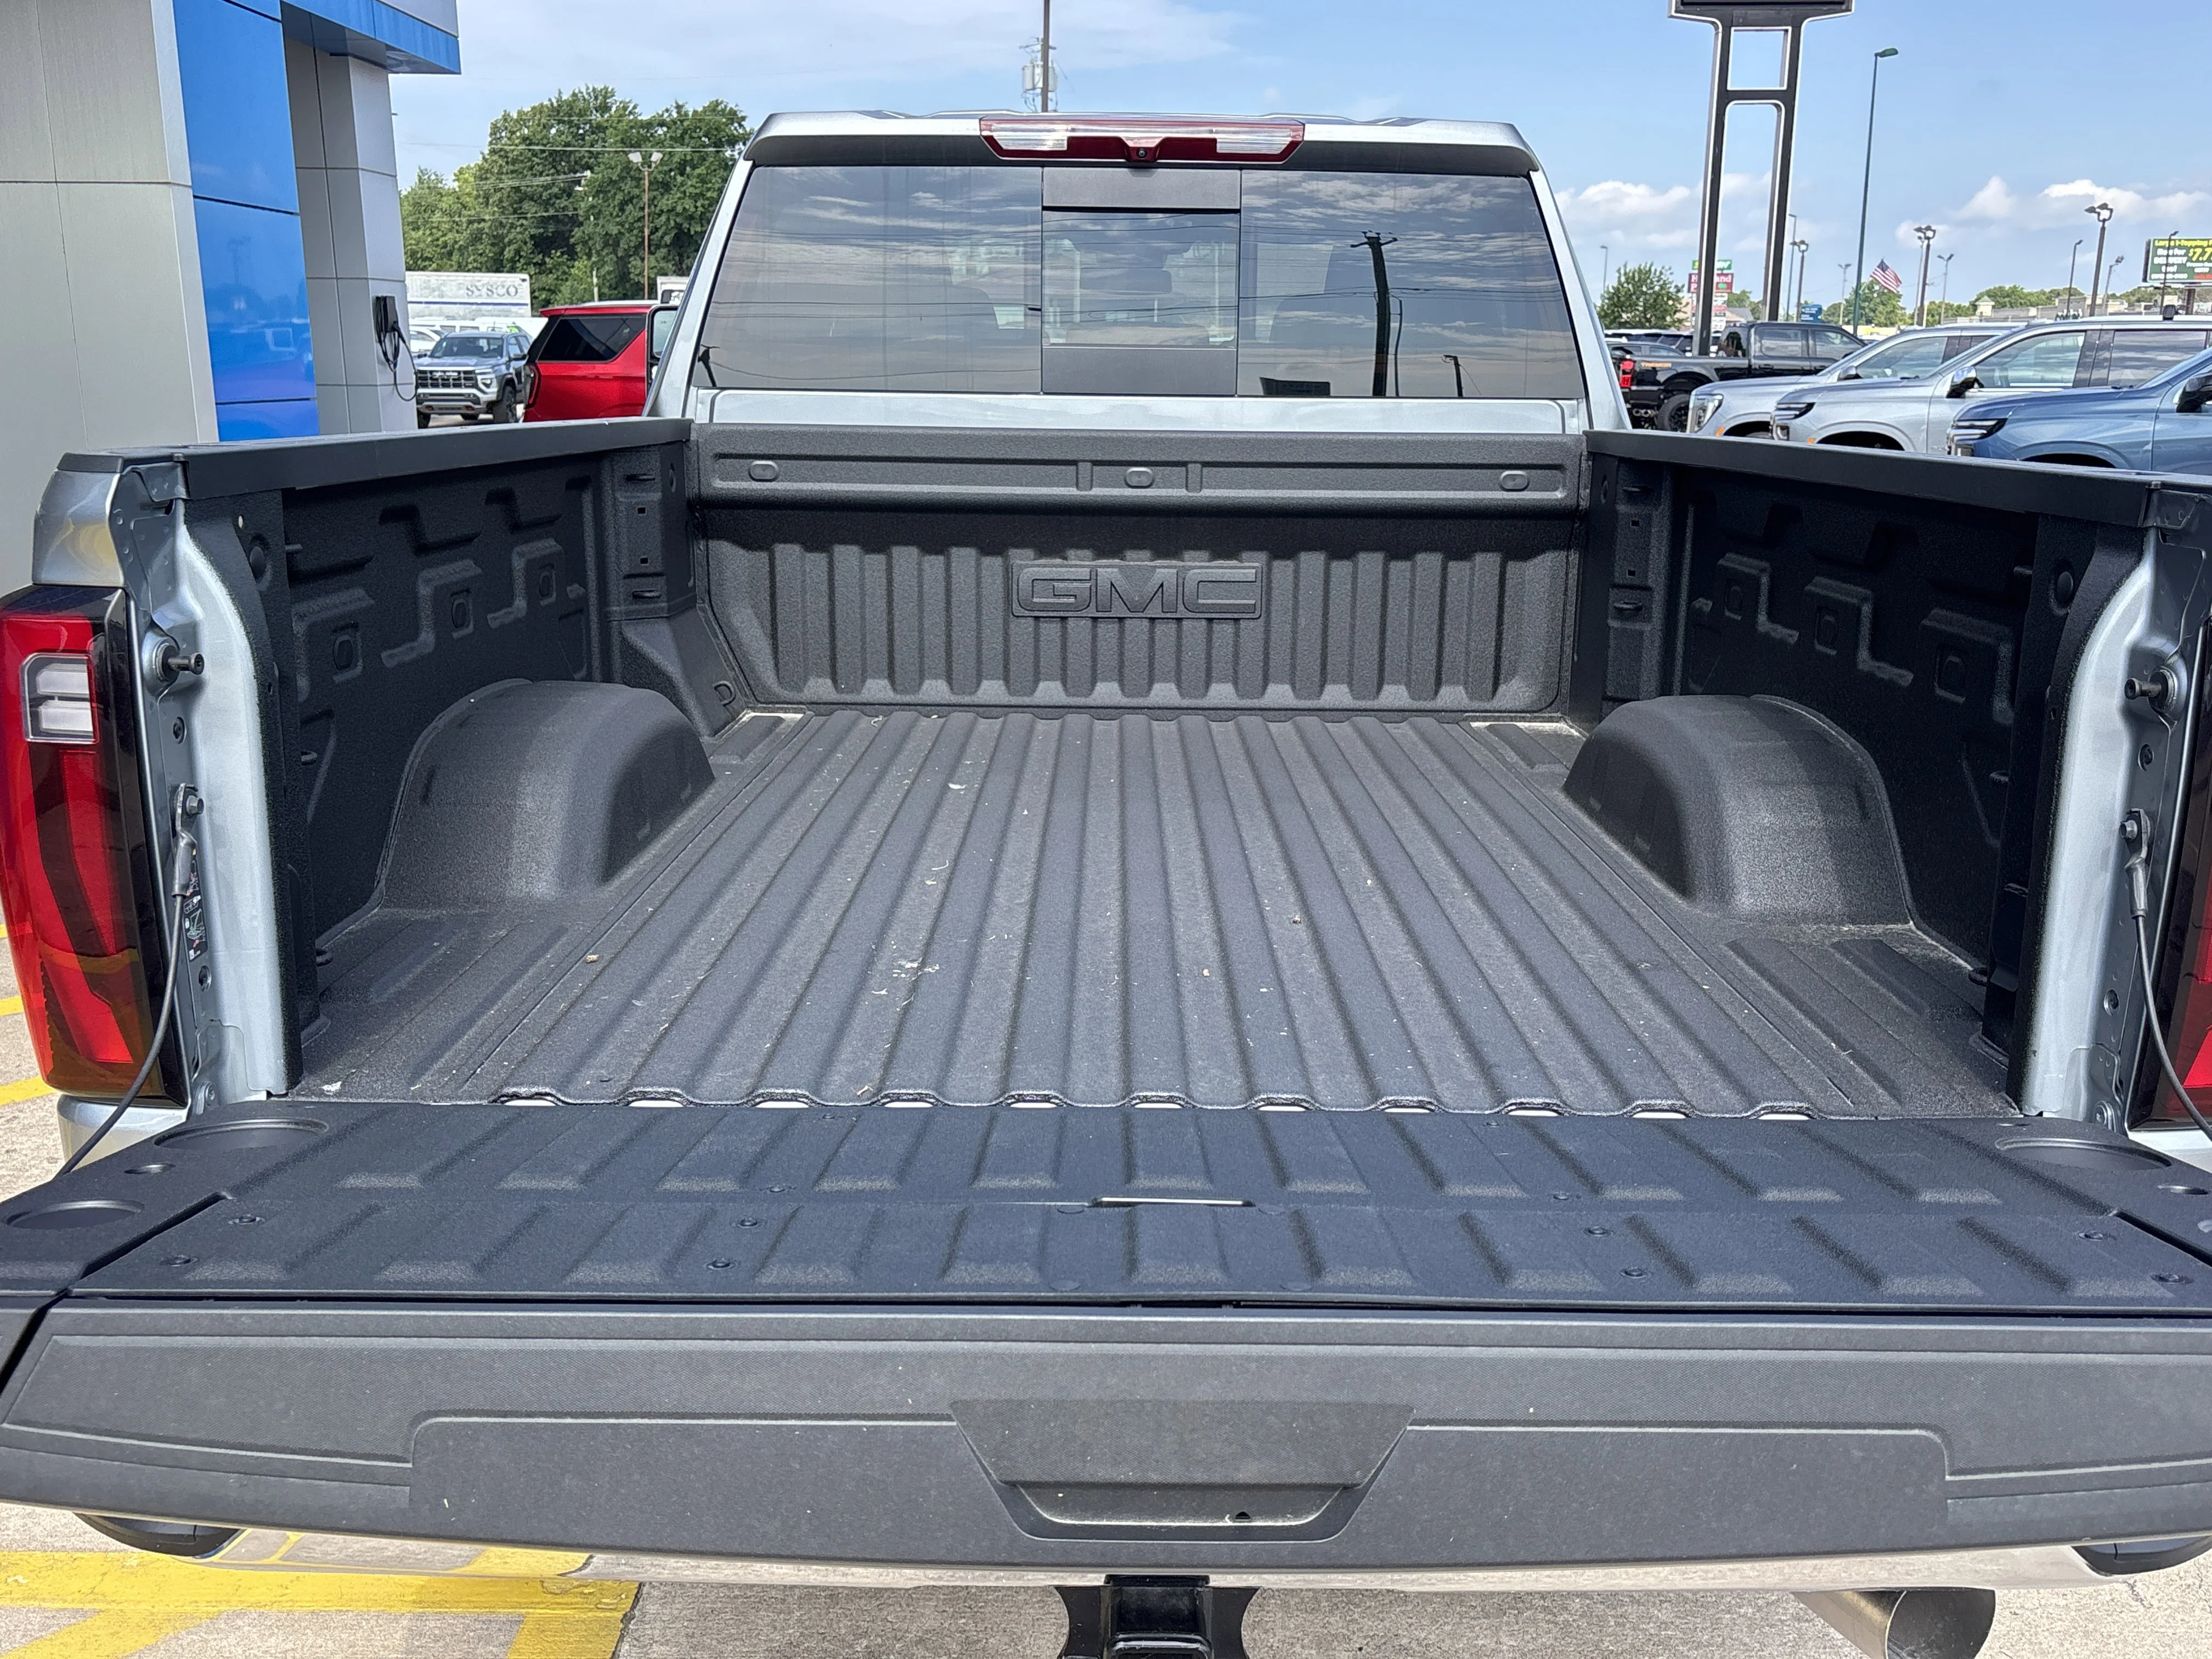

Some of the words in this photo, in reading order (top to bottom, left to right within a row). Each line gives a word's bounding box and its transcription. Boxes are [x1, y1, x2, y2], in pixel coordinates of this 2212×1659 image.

[2188, 247, 2212, 261] $7.7
[465, 284, 518, 297] SYSCO
[1018, 568, 1257, 613] GMC
